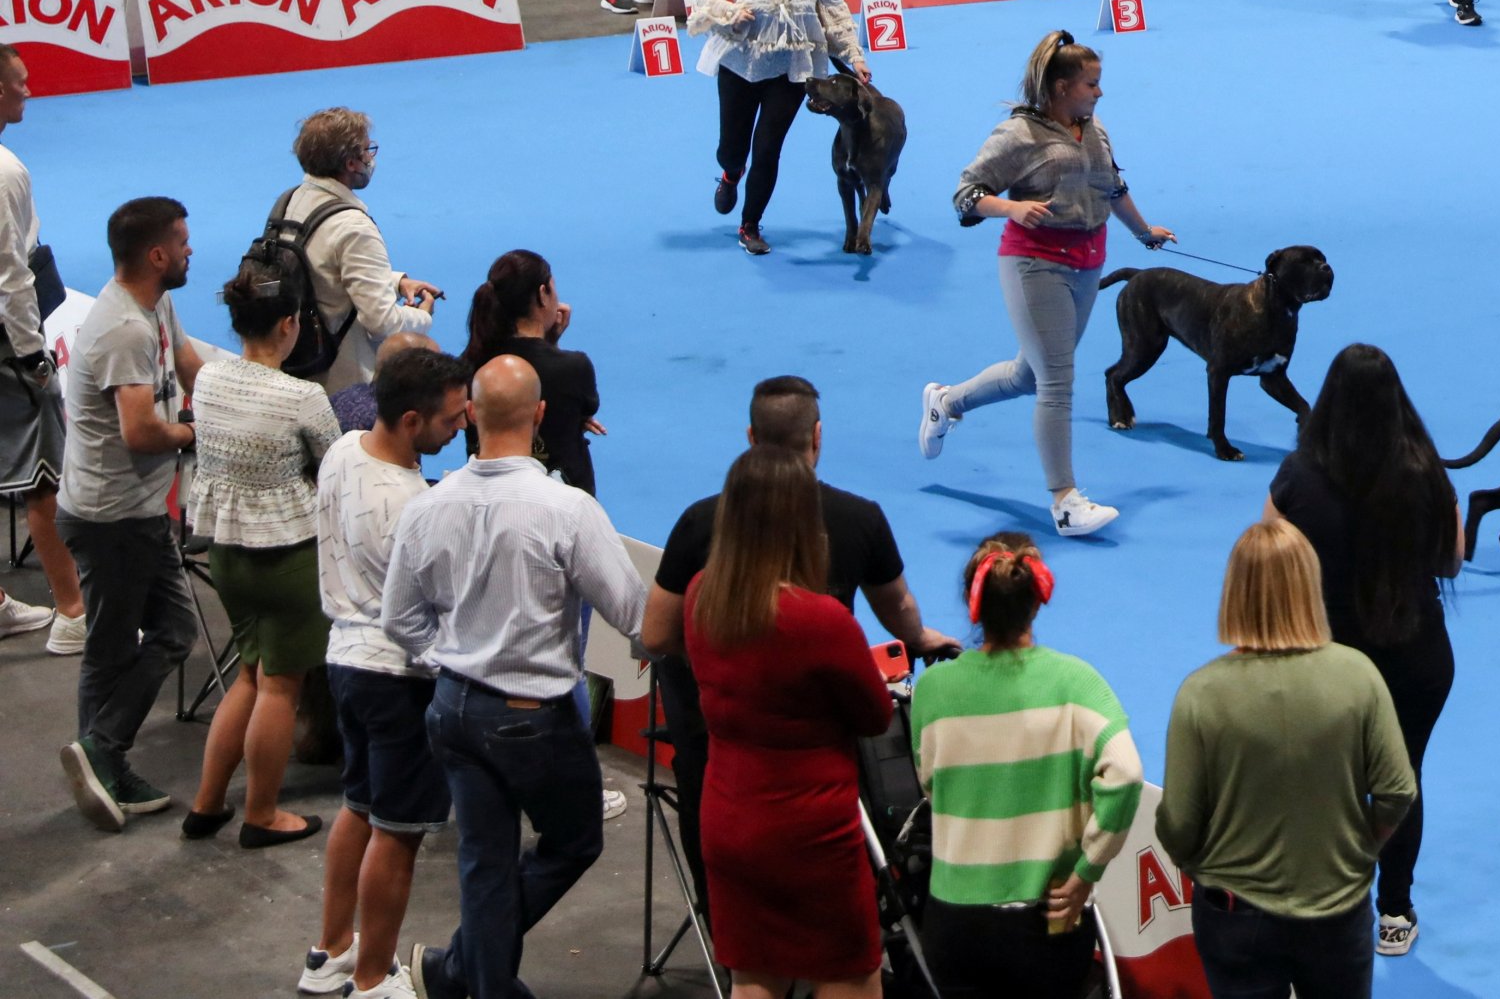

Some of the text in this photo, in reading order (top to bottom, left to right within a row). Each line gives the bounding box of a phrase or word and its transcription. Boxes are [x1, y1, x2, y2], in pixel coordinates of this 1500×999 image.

[867, 0, 898, 13] ARION
[1117, 0, 1139, 29] 3
[642, 23, 673, 37] ARION
[874, 17, 900, 49] 2
[652, 40, 672, 73] 1
